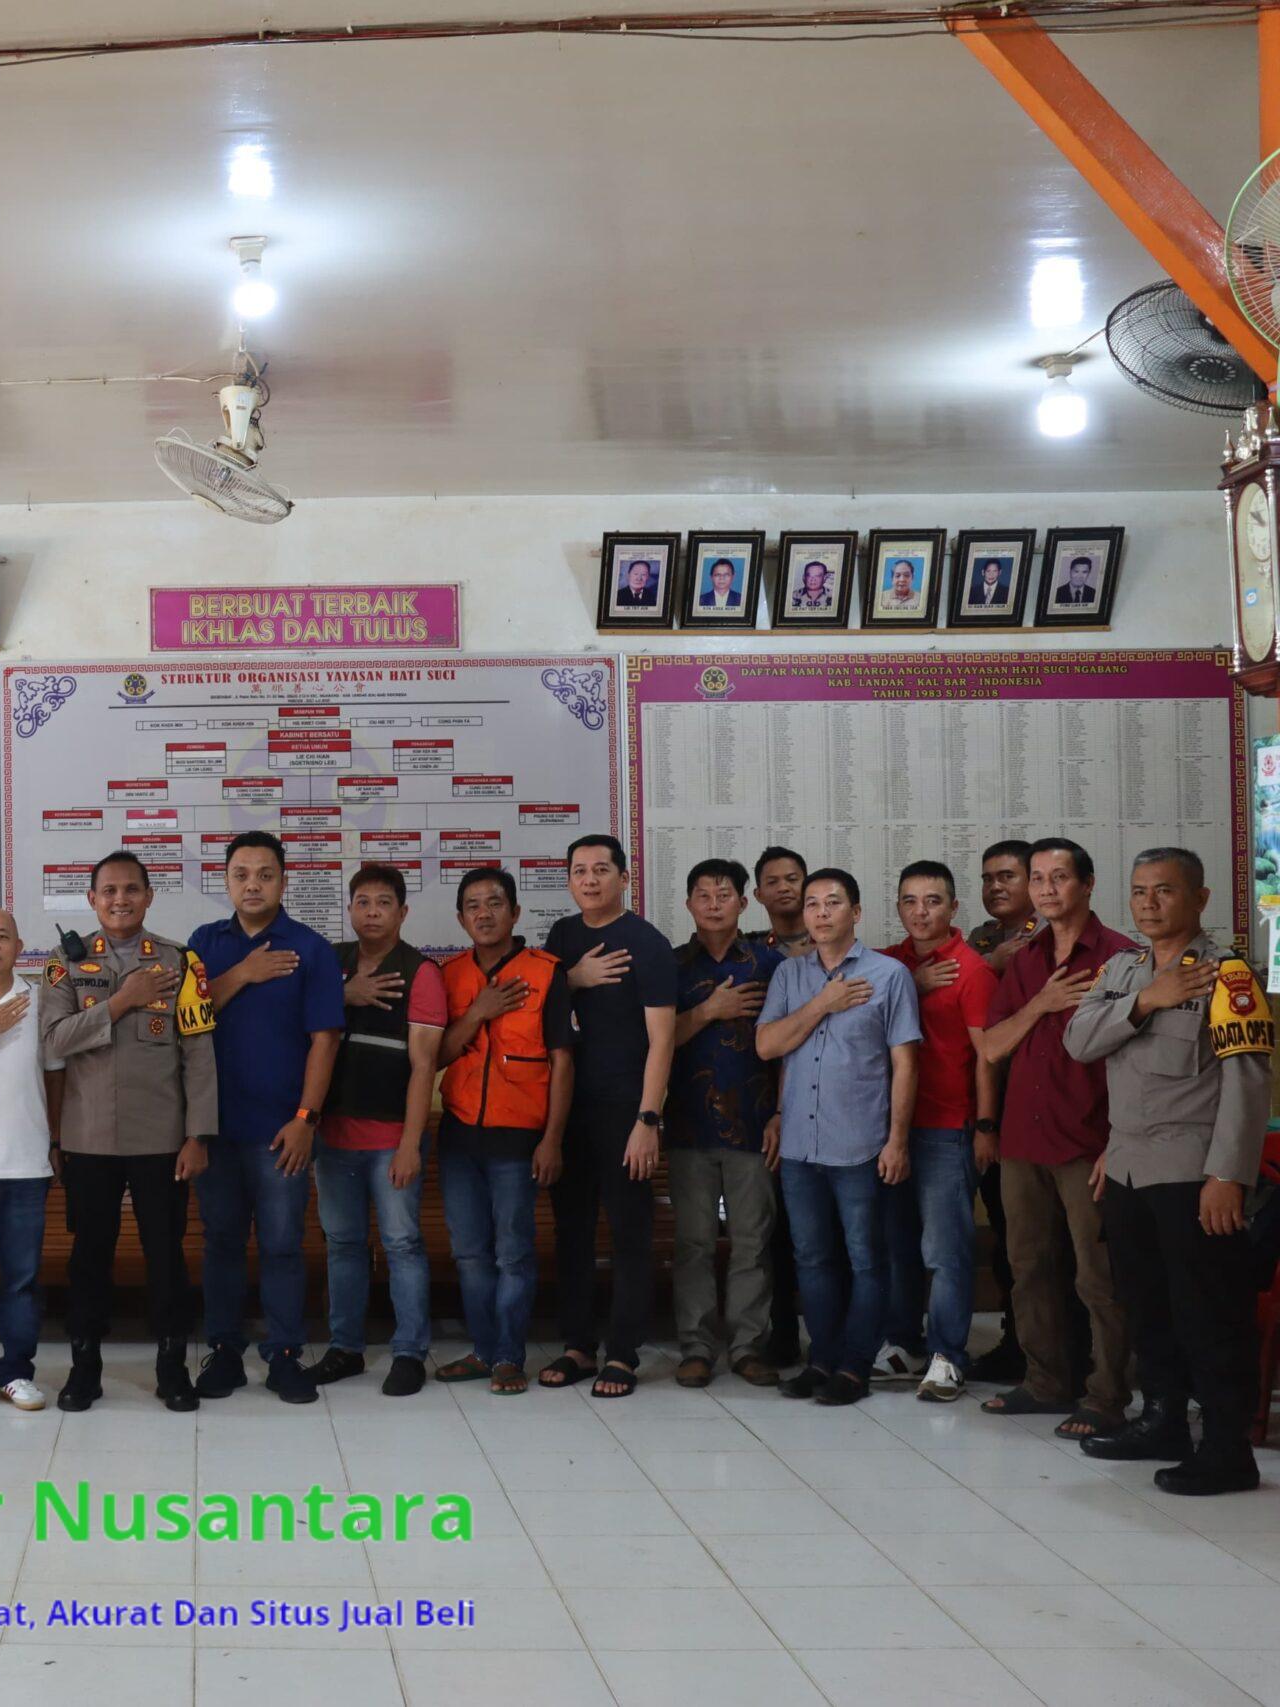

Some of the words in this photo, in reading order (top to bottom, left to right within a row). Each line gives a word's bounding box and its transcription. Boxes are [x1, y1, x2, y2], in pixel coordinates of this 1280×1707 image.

[189, 592, 305, 618] BERBUAT
[311, 591, 417, 617] TERBAIK
[182, 618, 276, 645] IKHLAS
[283, 618, 342, 643] DAN
[349, 616, 428, 643] TULUS
[161, 673, 231, 684] STRUKTUR
[238, 671, 320, 683] ORGANISASI
[326, 671, 383, 682] YAYASAN
[390, 670, 421, 681] HATI
[428, 669, 456, 681] SUCI
[741, 667, 787, 676] DAFTAR
[791, 667, 824, 676] NAMA
[827, 667, 851, 675] DAN
[854, 666, 894, 675] MARGA
[898, 666, 952, 675] ANGGOTA
[956, 666, 1008, 674] YAYASAN
[1012, 665, 1040, 674] HATI
[1043, 665, 1070, 674] SUCI
[1074, 665, 1128, 674] NGABANG
[828, 679, 855, 687] KAB.
[859, 679, 905, 687] LANDAK
[917, 678, 939, 686] KAL
[944, 678, 966, 686] BAR
[979, 677, 1042, 686] INDONESIA
[872, 689, 913, 698] TAHUN
[915, 689, 943, 697] 1983
[946, 689, 967, 697] S/D
[971, 688, 999, 697] 2018
[180, 1006, 198, 1030] KA
